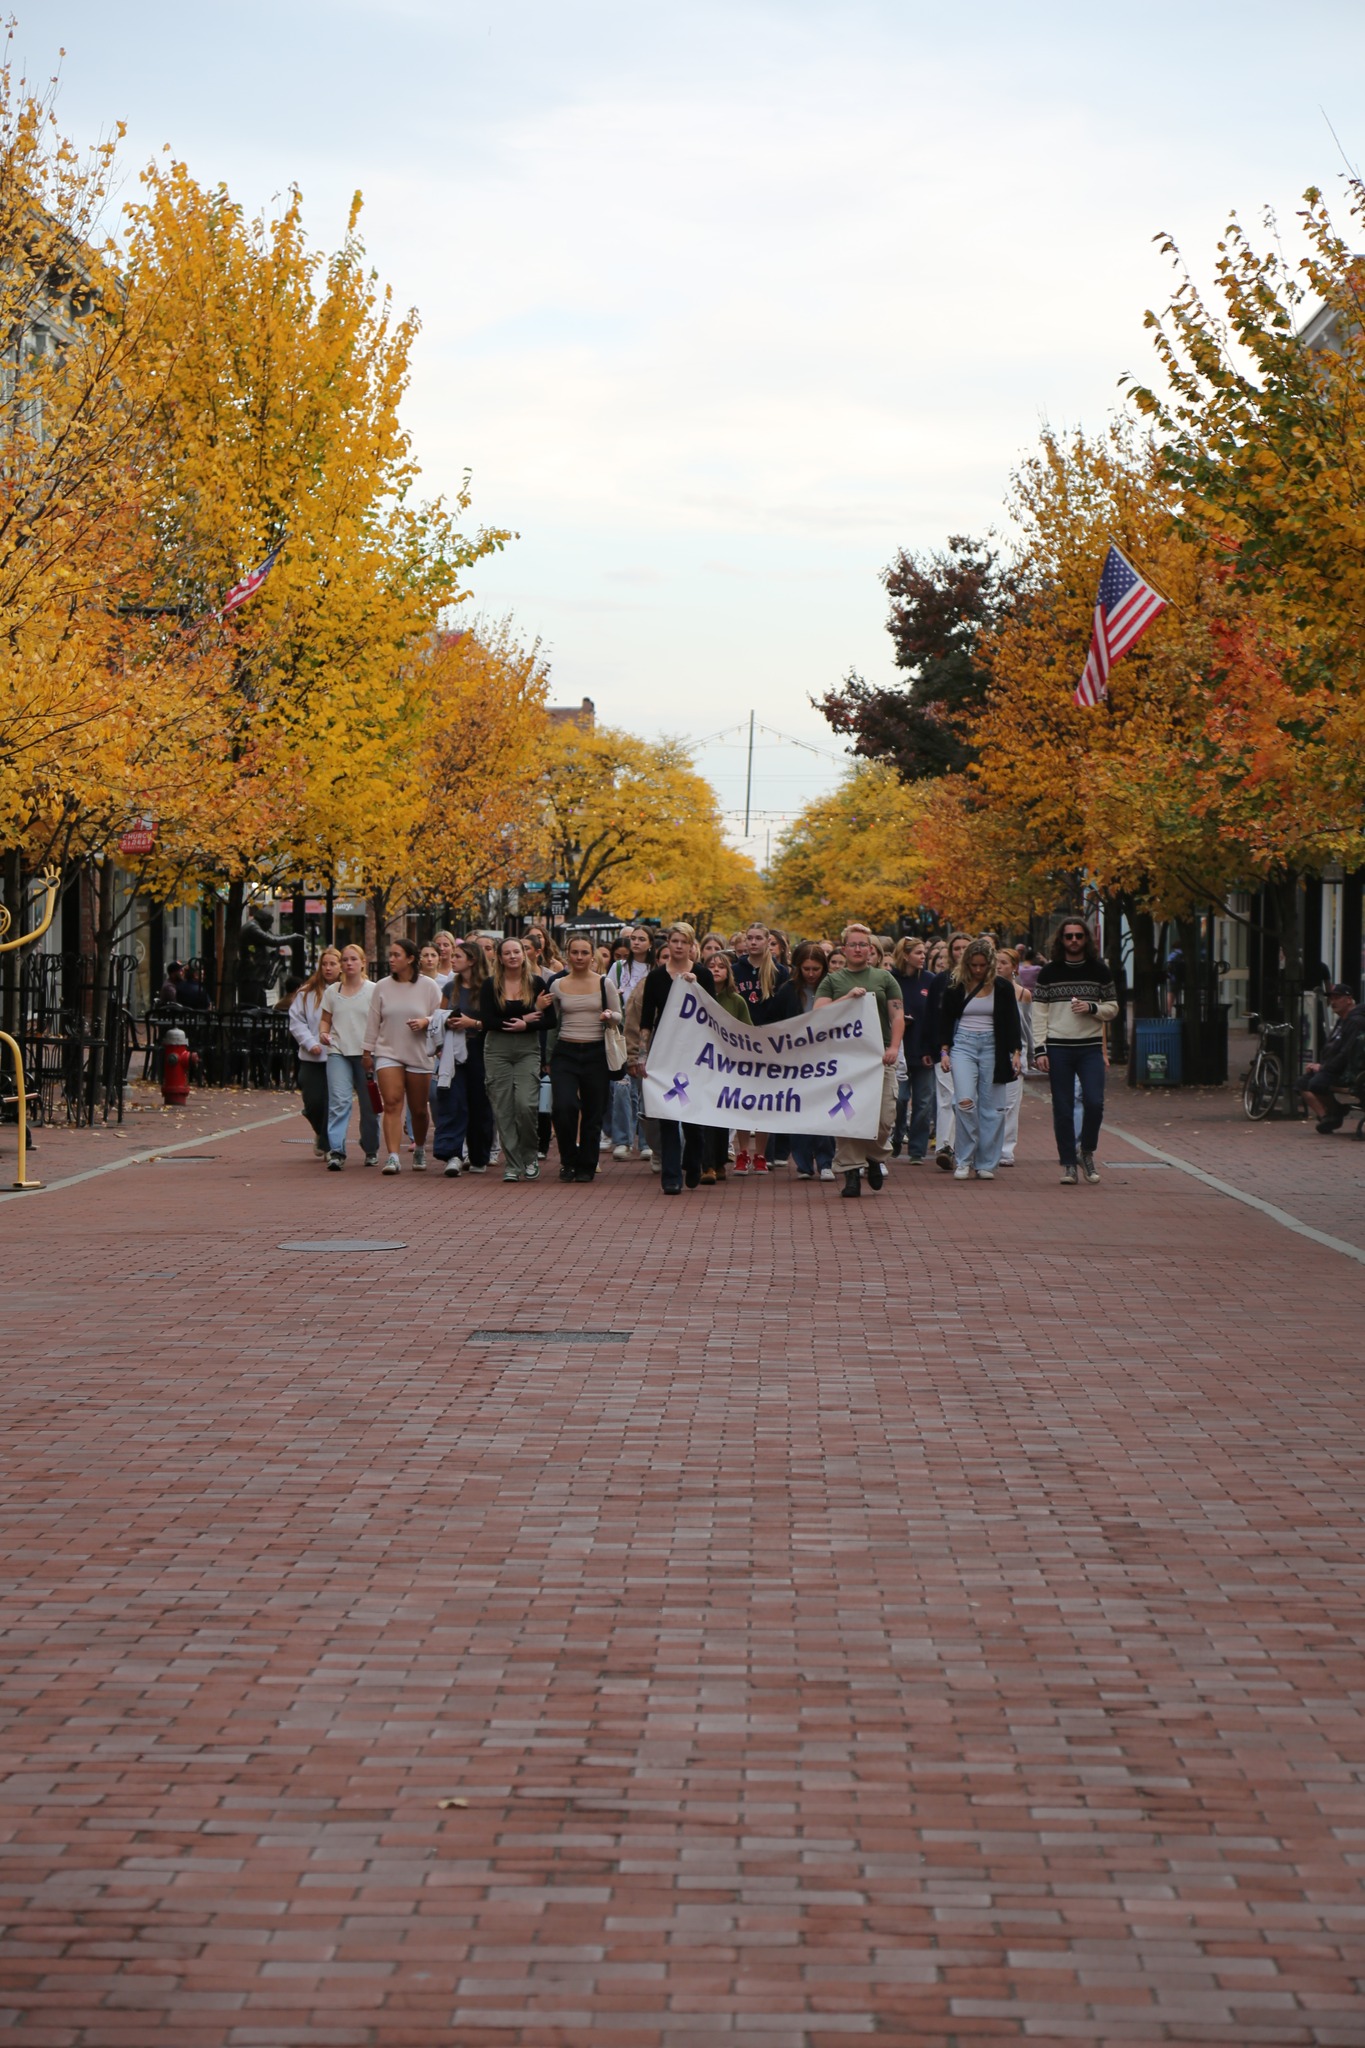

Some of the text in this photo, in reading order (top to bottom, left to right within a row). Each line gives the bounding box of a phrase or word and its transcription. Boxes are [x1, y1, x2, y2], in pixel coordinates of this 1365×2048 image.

[679, 993, 863, 1054] Domestic Violence
[694, 1042, 838, 1080] Awareness
[716, 1086, 802, 1113] Month
